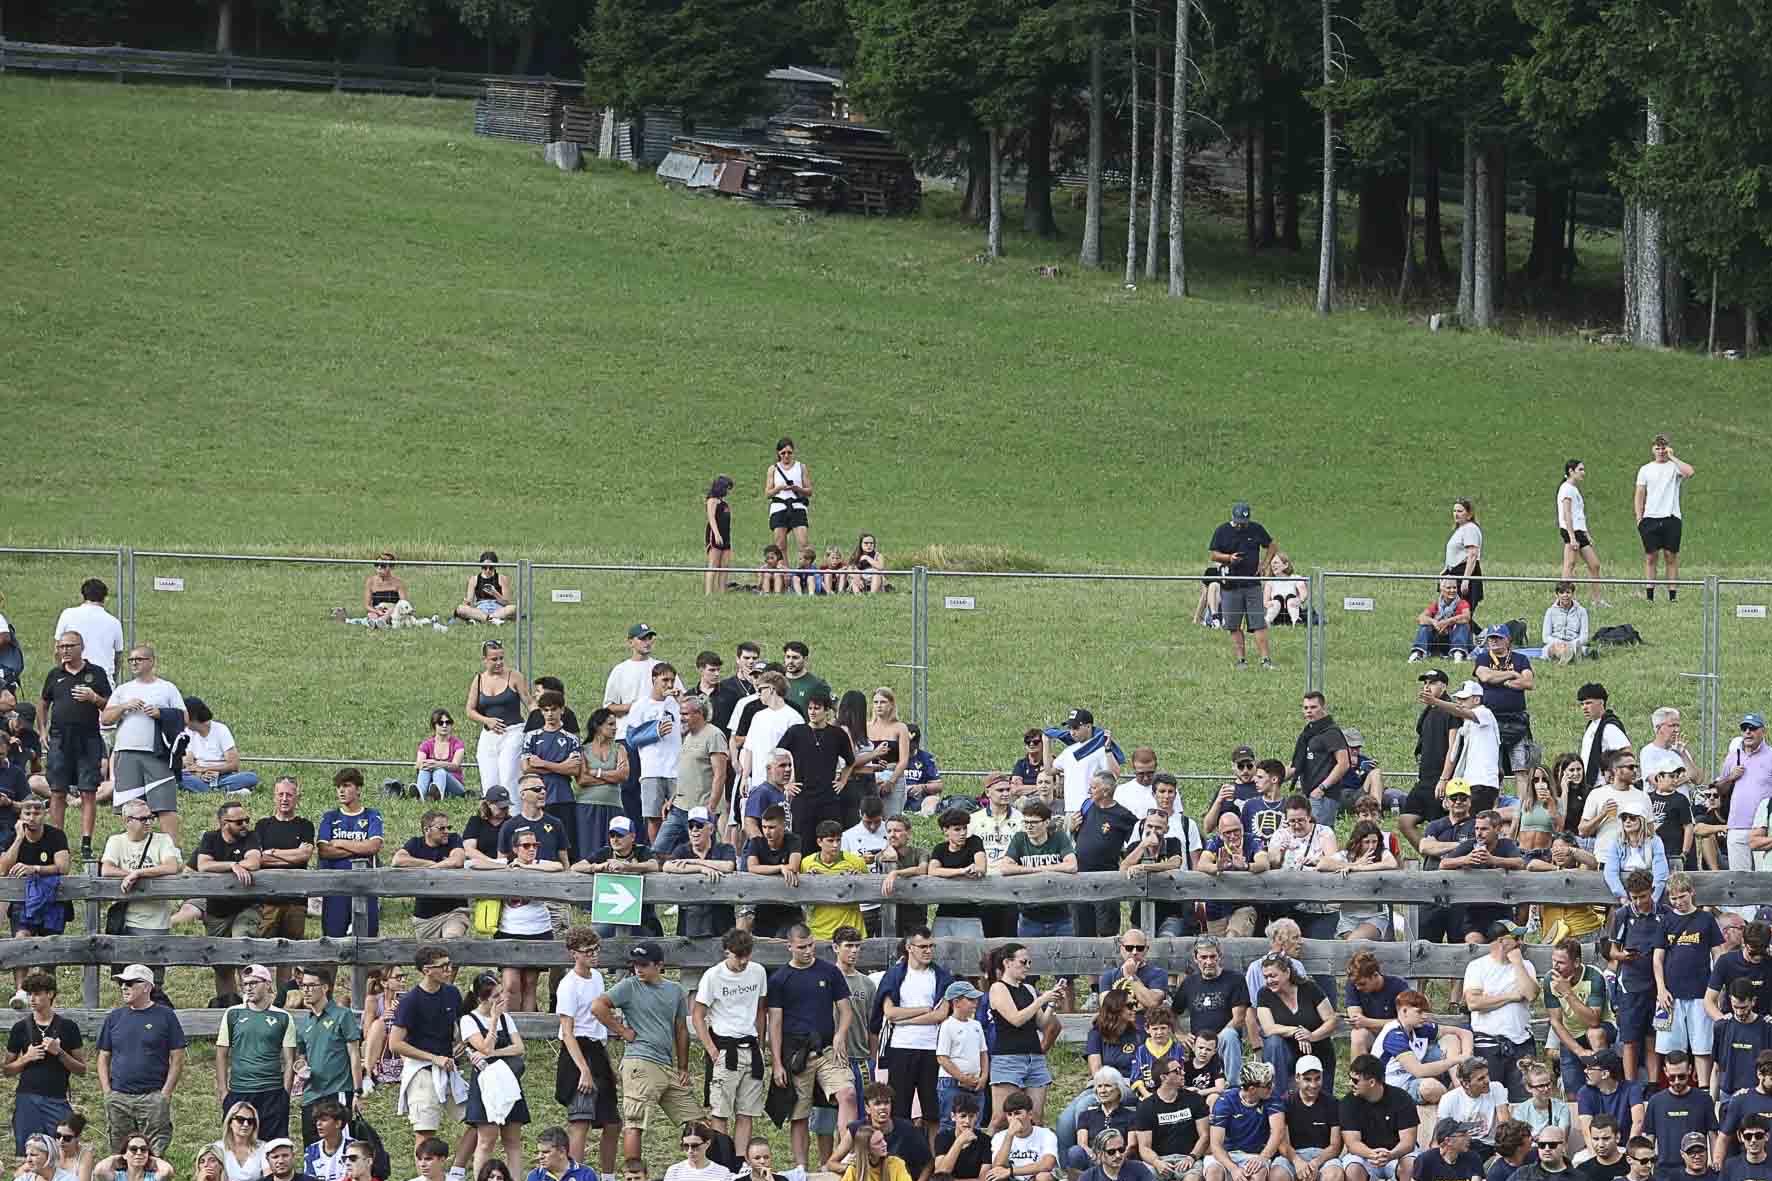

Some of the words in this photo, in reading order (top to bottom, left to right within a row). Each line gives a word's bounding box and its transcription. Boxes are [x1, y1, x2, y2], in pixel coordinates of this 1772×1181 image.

[333, 827, 367, 841] Sinergy
[723, 982, 757, 997] Barbour
[1160, 1110, 1190, 1122] NOTHING
